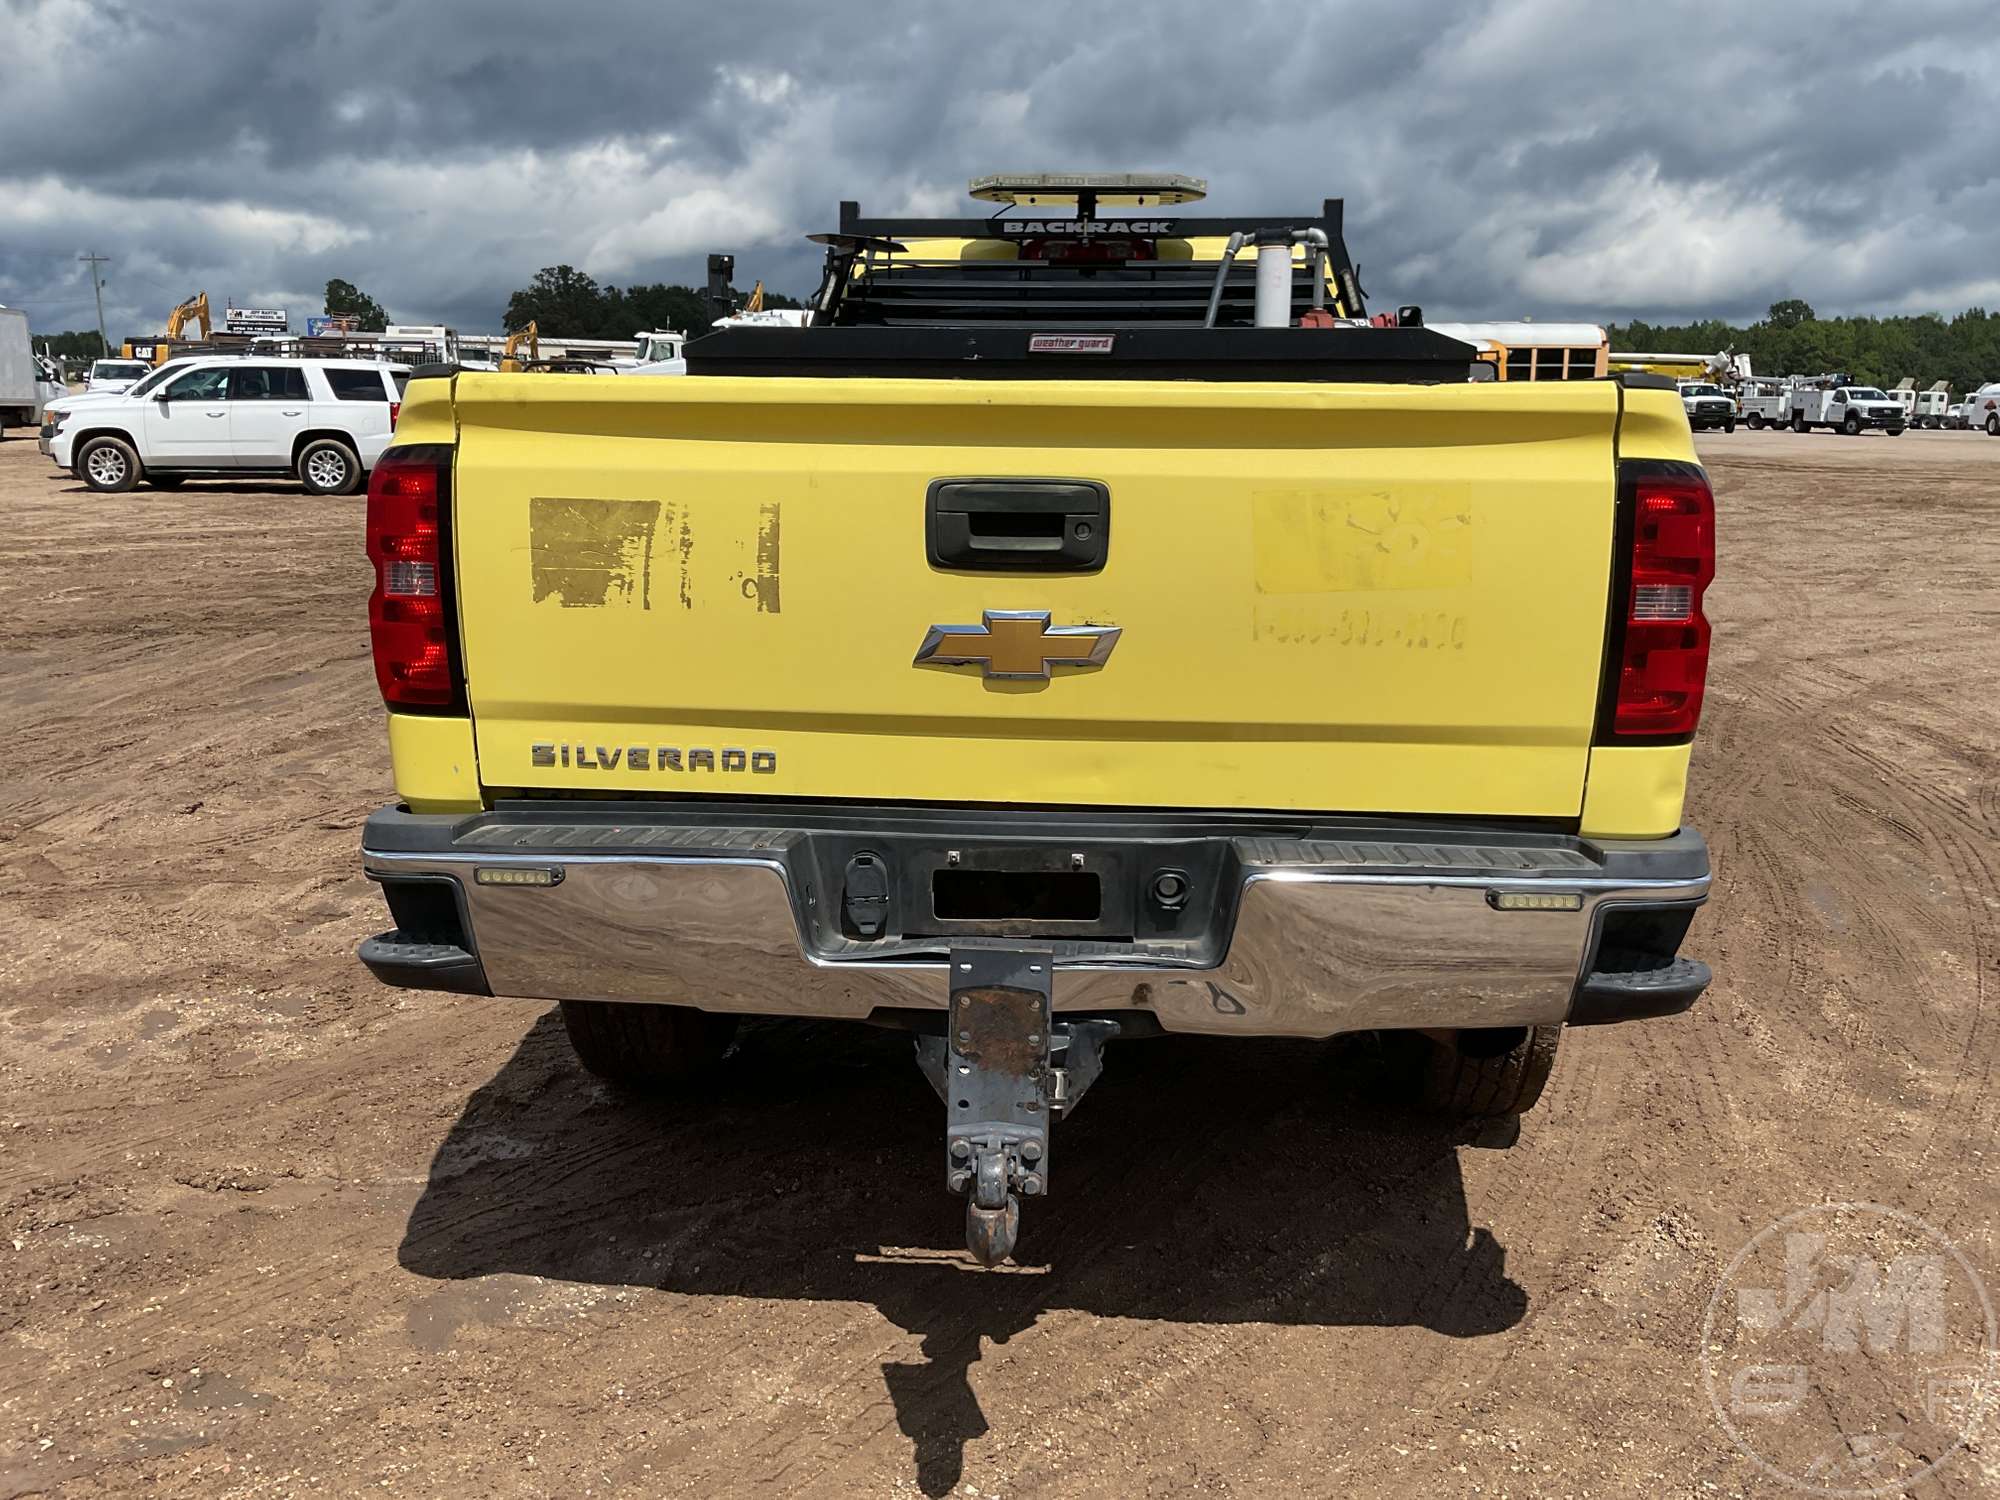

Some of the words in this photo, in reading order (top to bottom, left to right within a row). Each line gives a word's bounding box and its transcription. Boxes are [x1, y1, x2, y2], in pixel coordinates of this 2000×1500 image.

[1003, 222, 1171, 233] BACKRACK
[1033, 338, 1077, 348] weather
[1078, 338, 1110, 350] guard
[135, 347, 152, 358] CAT
[531, 744, 776, 774] SILVERADO
